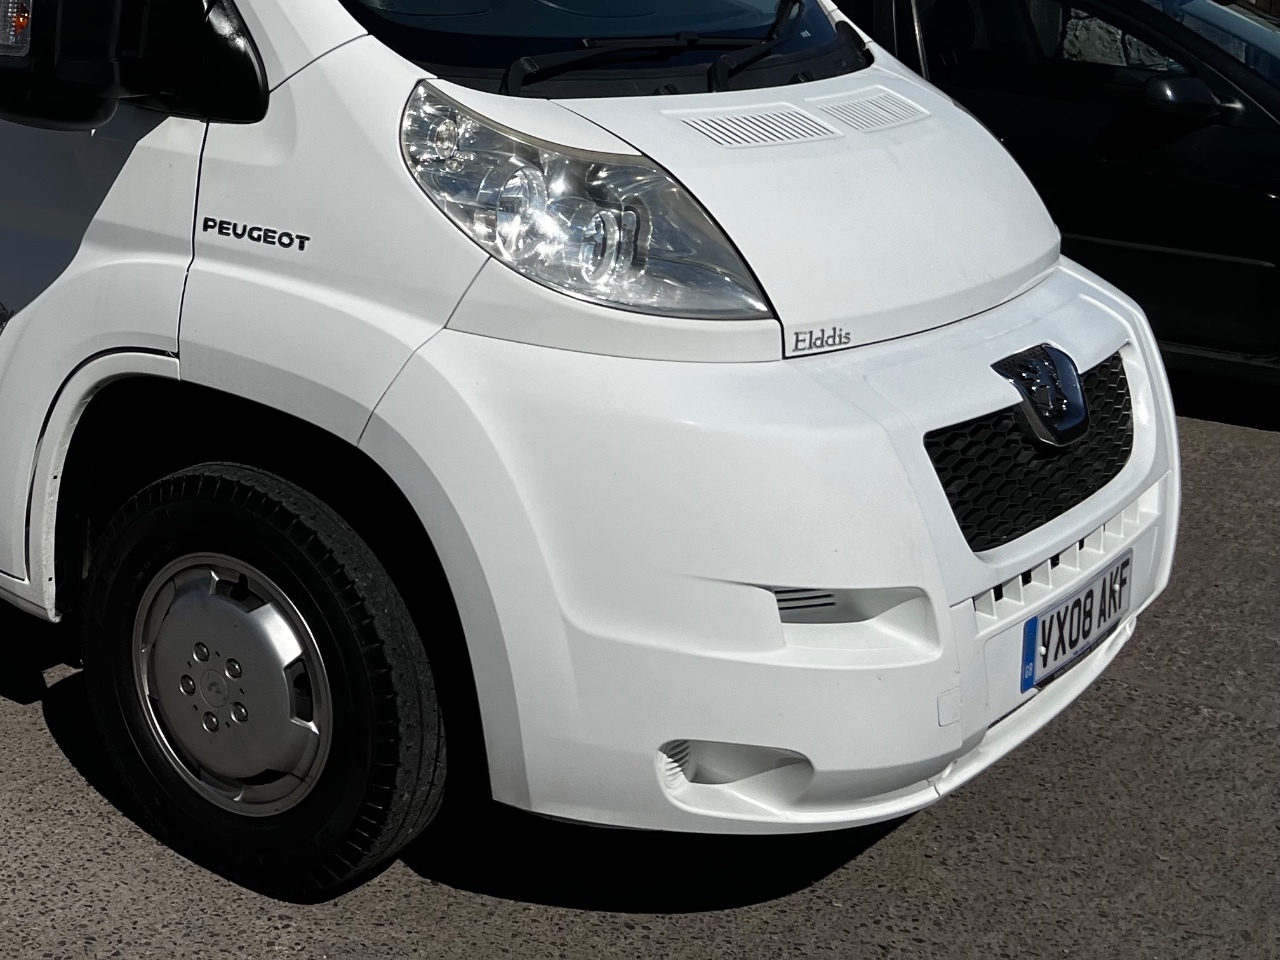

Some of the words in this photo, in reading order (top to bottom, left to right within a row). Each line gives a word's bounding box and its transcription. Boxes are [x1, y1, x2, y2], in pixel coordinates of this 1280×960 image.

[203, 217, 311, 251] PEUGEOT
[792, 327, 851, 352] Elddis
[1097, 557, 1130, 629] AKF
